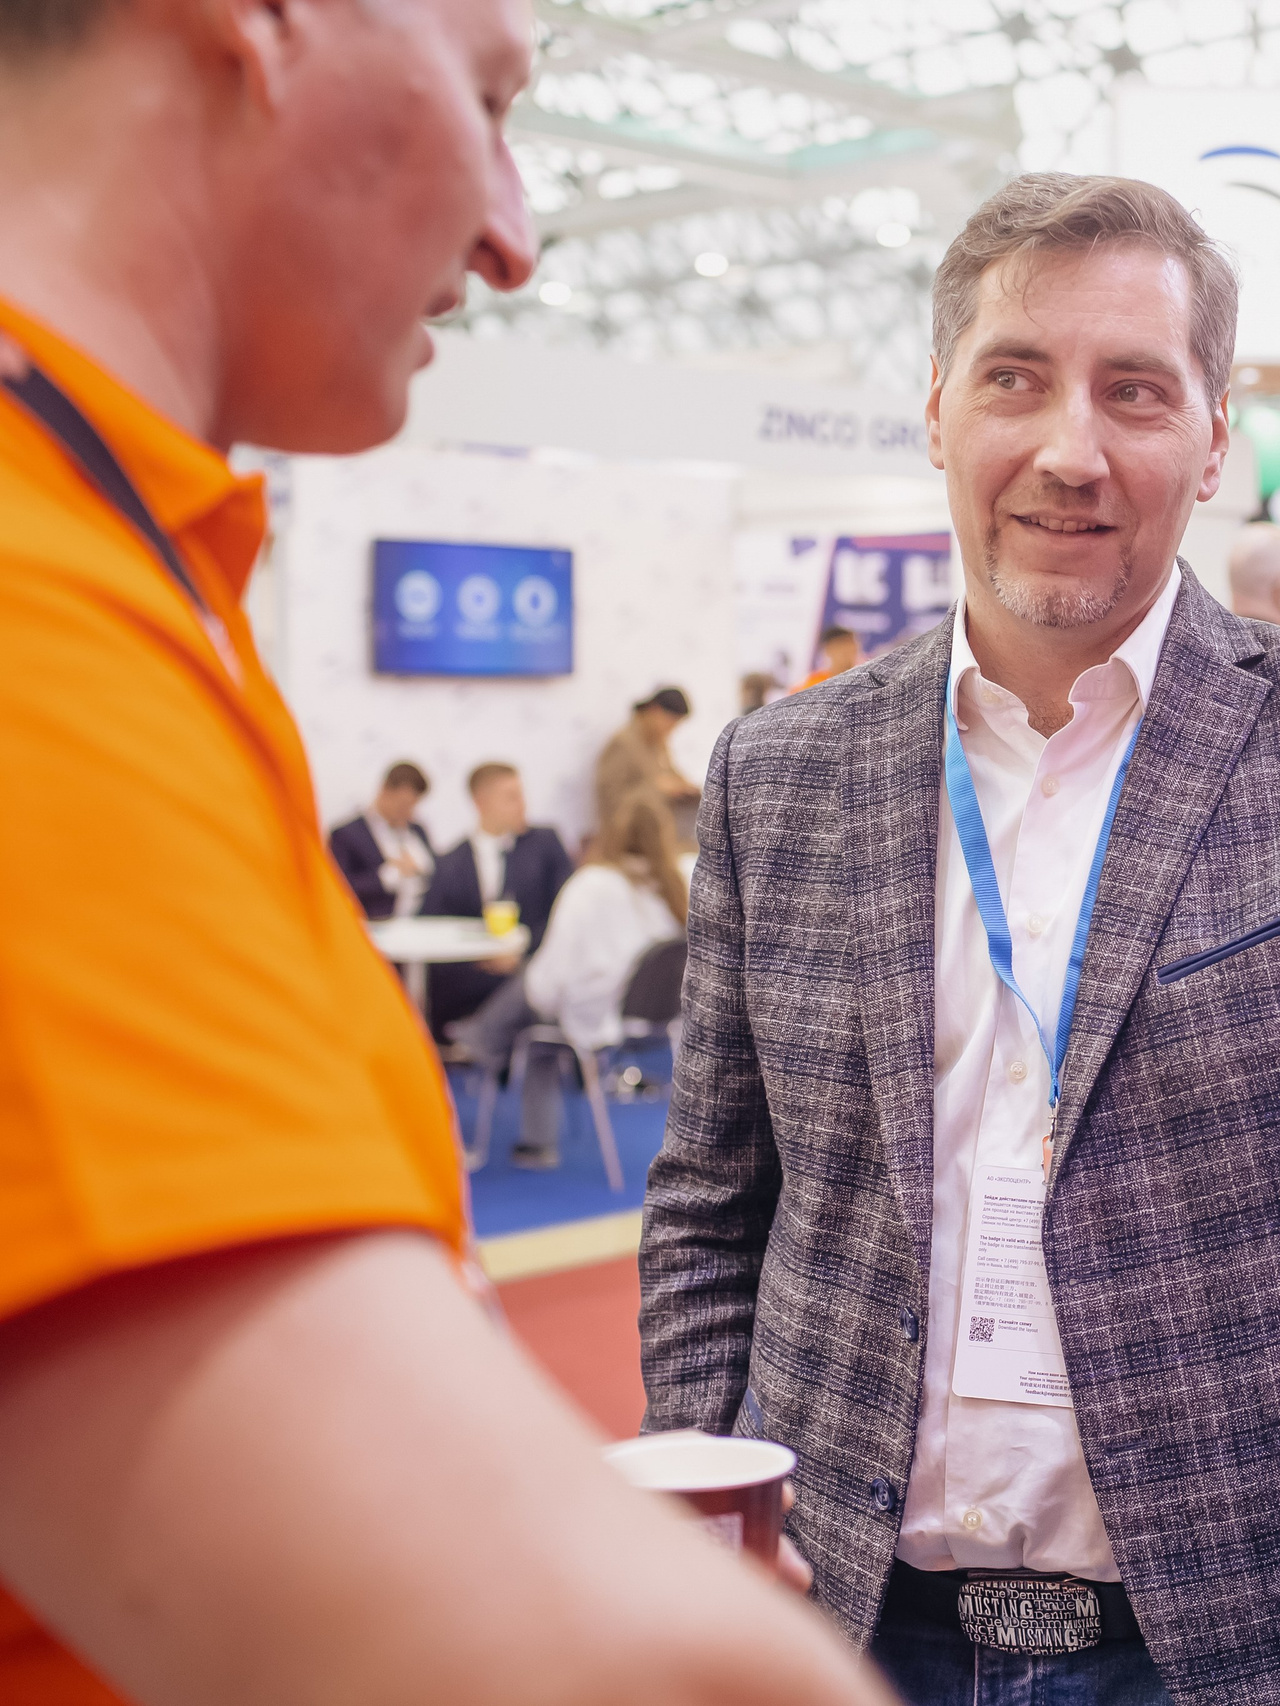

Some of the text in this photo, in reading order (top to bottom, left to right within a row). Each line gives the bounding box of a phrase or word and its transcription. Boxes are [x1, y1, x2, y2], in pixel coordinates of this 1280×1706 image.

[760, 406, 858, 447] ZINCO
[1009, 1589, 1053, 1600] Denim
[958, 1593, 1034, 1619] MUSTANG
[1033, 1600, 1076, 1611] True
[967, 1613, 1002, 1627] True
[1008, 1617, 1063, 1628] Denim
[1034, 1611, 1076, 1619] Denim
[968, 1633, 996, 1644] 1932
[996, 1626, 1079, 1647] MUSTANG
